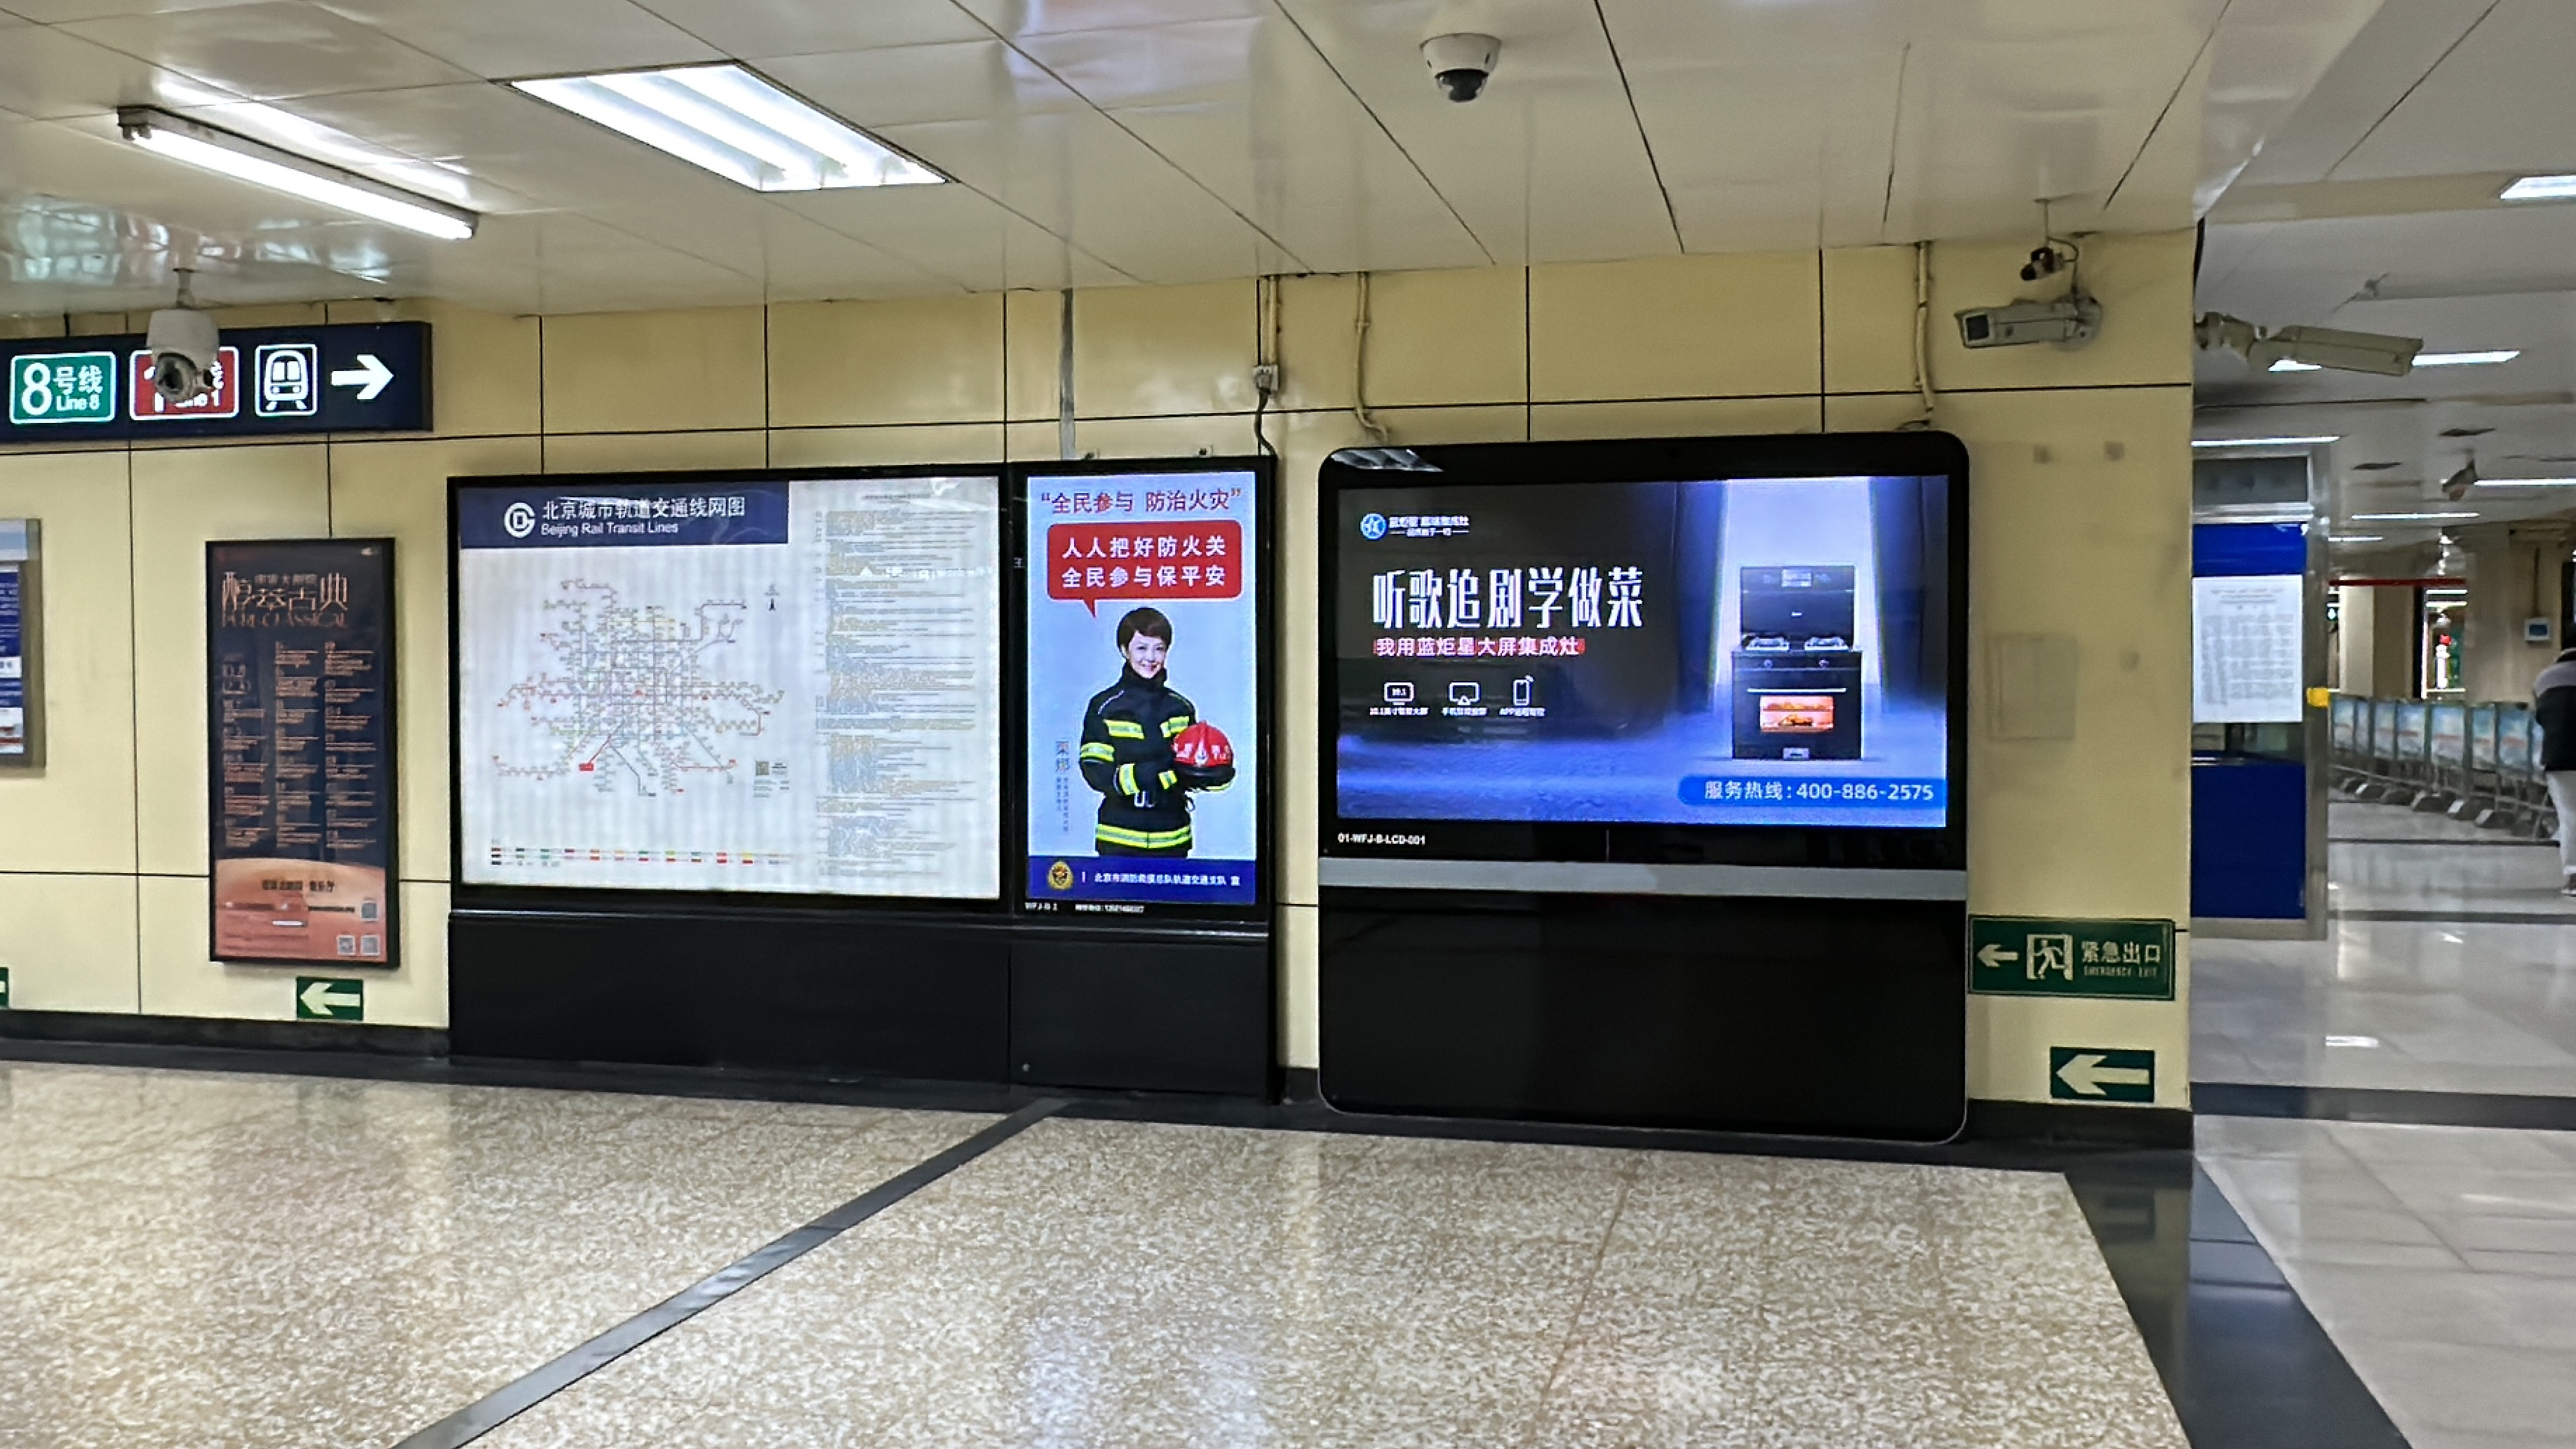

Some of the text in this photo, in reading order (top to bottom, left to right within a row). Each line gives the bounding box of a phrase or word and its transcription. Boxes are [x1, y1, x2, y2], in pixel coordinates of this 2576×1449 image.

[22, 362, 104, 415] 8号线
[56, 393, 100, 411] Line 8
[542, 497, 746, 520] 北京城市轨道交通线网图
[542, 520, 678, 537] Beijing Rail Transit Lines
[1061, 534, 1226, 559] 人人把好防火关
[1061, 564, 1226, 588] 全民参与保平安
[1372, 565, 1644, 629] 听歌追剧学做菜
[1376, 636, 1580, 656] 我用蓝炬星大屏集成灶
[2081, 941, 2161, 963] 紧急出口
